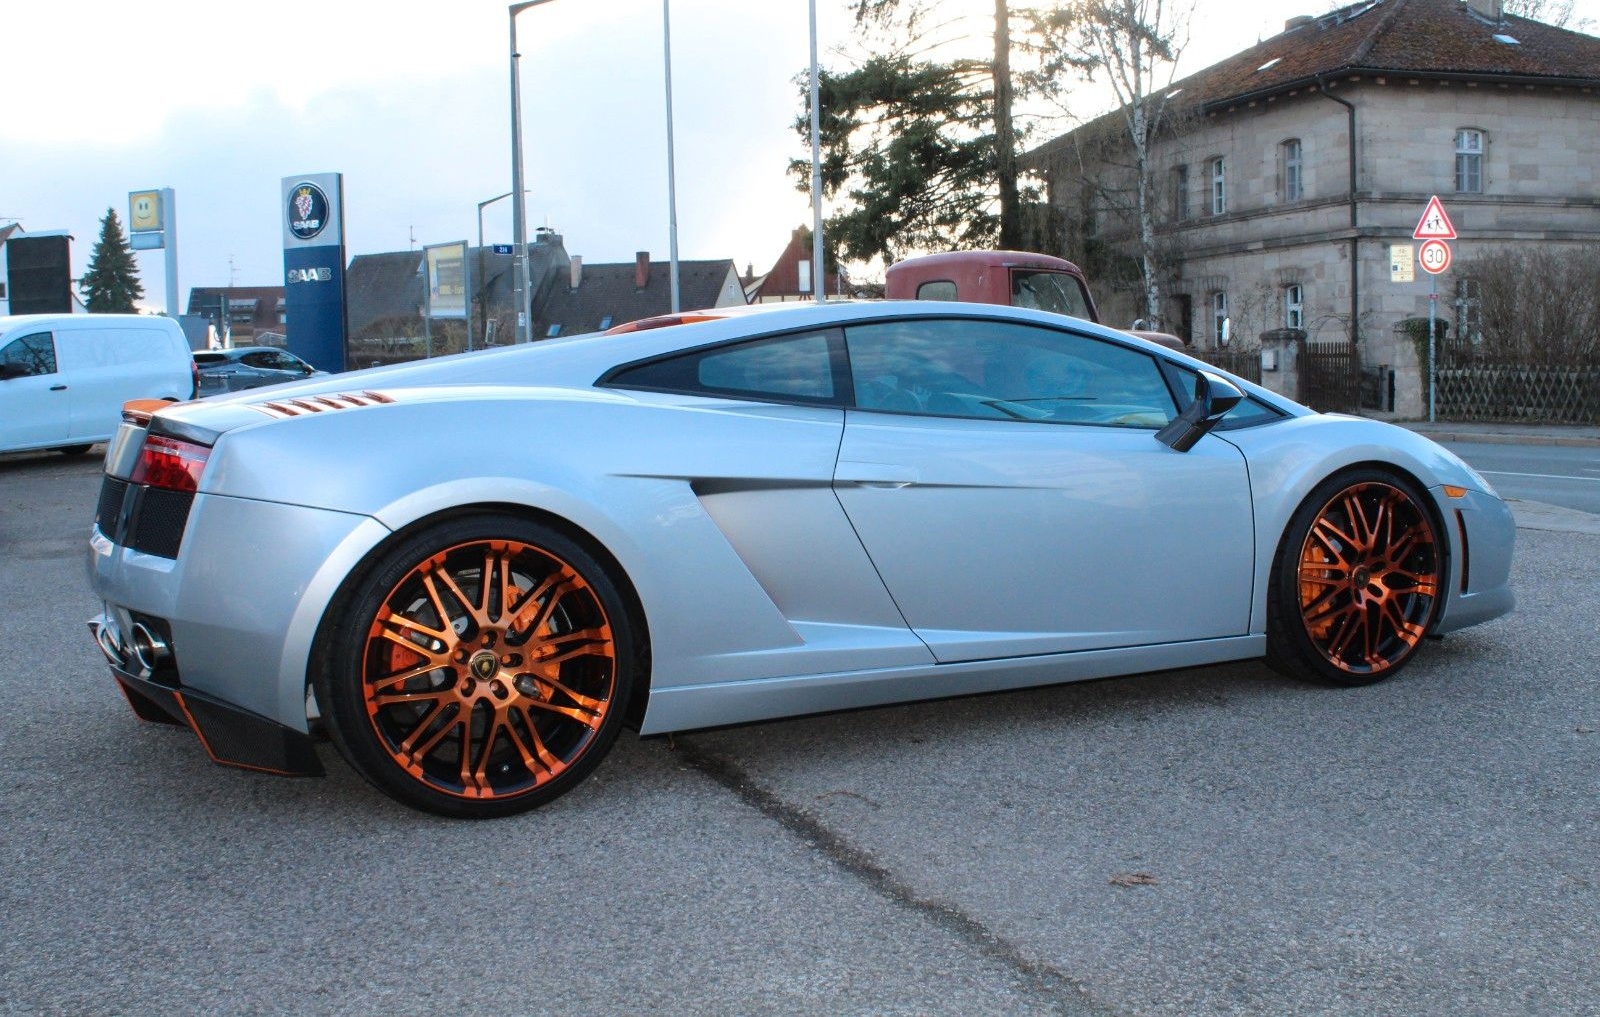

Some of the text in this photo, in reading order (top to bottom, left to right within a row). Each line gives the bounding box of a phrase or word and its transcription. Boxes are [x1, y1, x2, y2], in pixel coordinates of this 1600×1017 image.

[293, 219, 320, 230] SAAB
[1426, 248, 1443, 264] 30
[287, 267, 332, 284] SAAB
